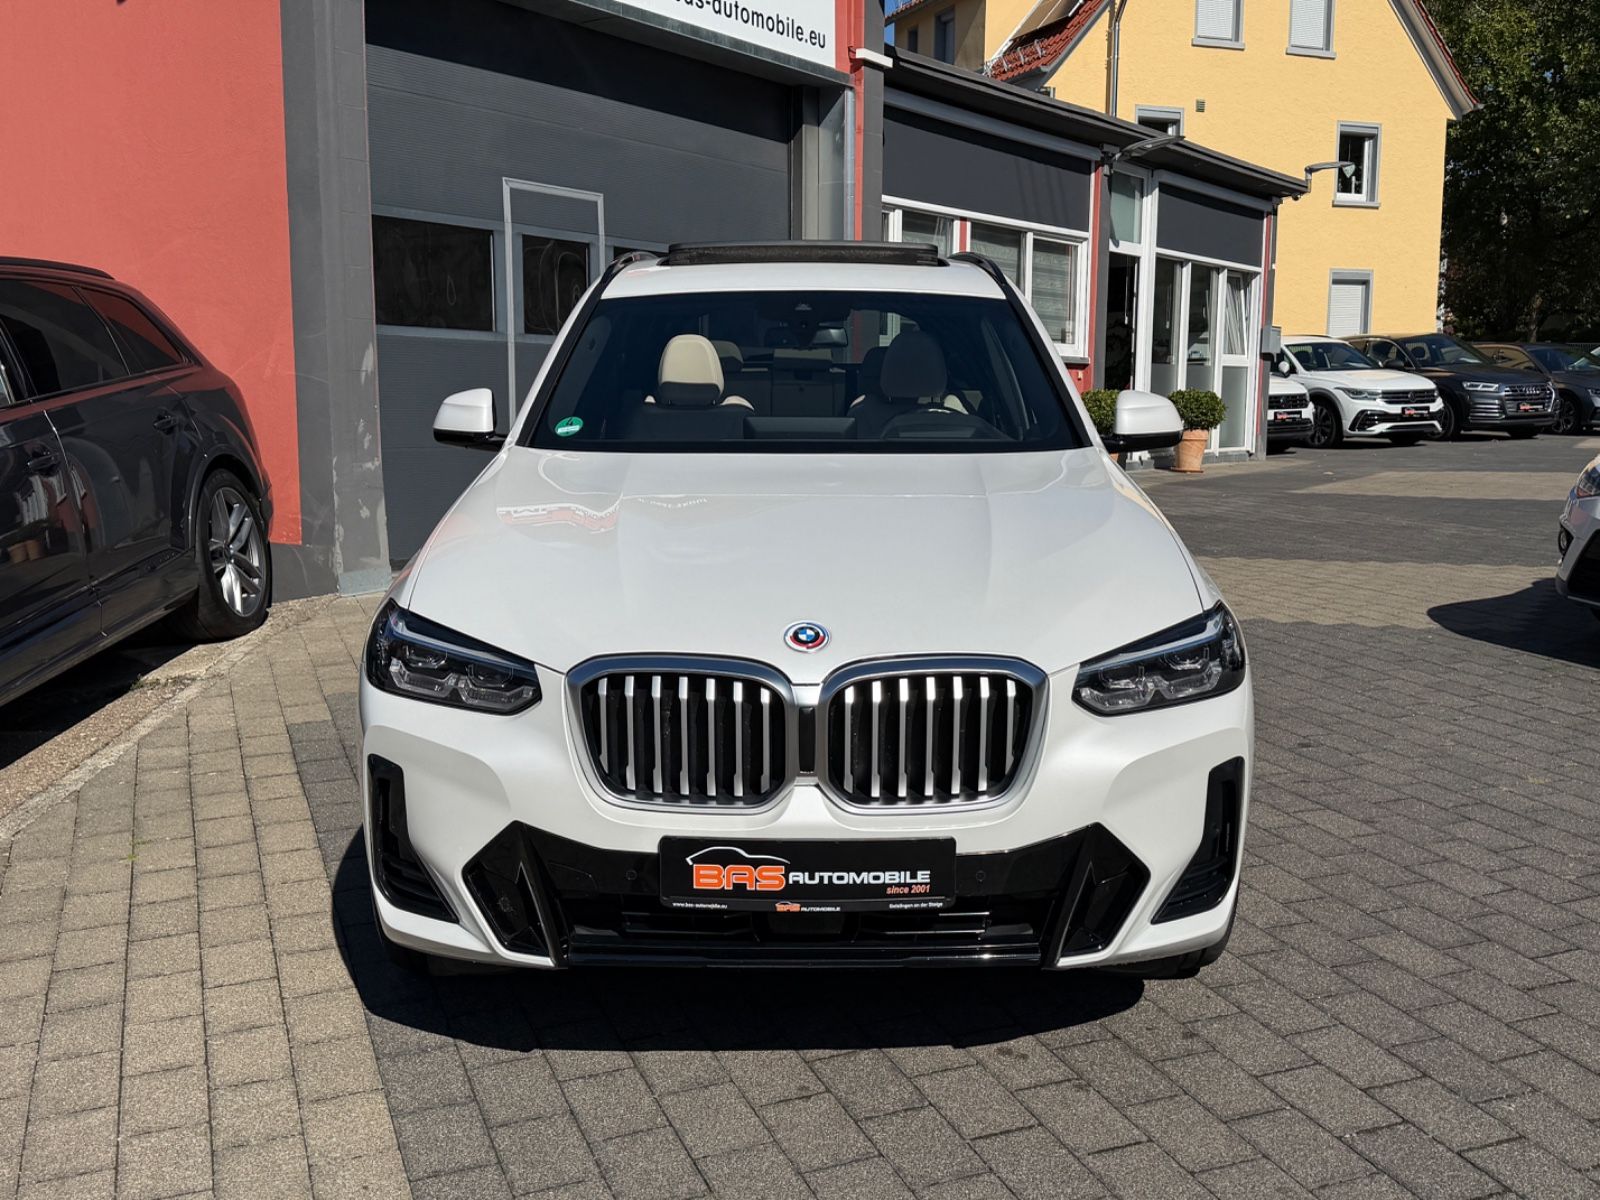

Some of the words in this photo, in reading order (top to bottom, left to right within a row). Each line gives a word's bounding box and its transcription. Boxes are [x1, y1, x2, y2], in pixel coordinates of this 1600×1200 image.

[675, 0, 827, 49] s-automobile.eu
[693, 864, 786, 891] BAS
[788, 870, 931, 885] AUTOMOBILE
[886, 885, 910, 895] since
[910, 884, 931, 894] 2001
